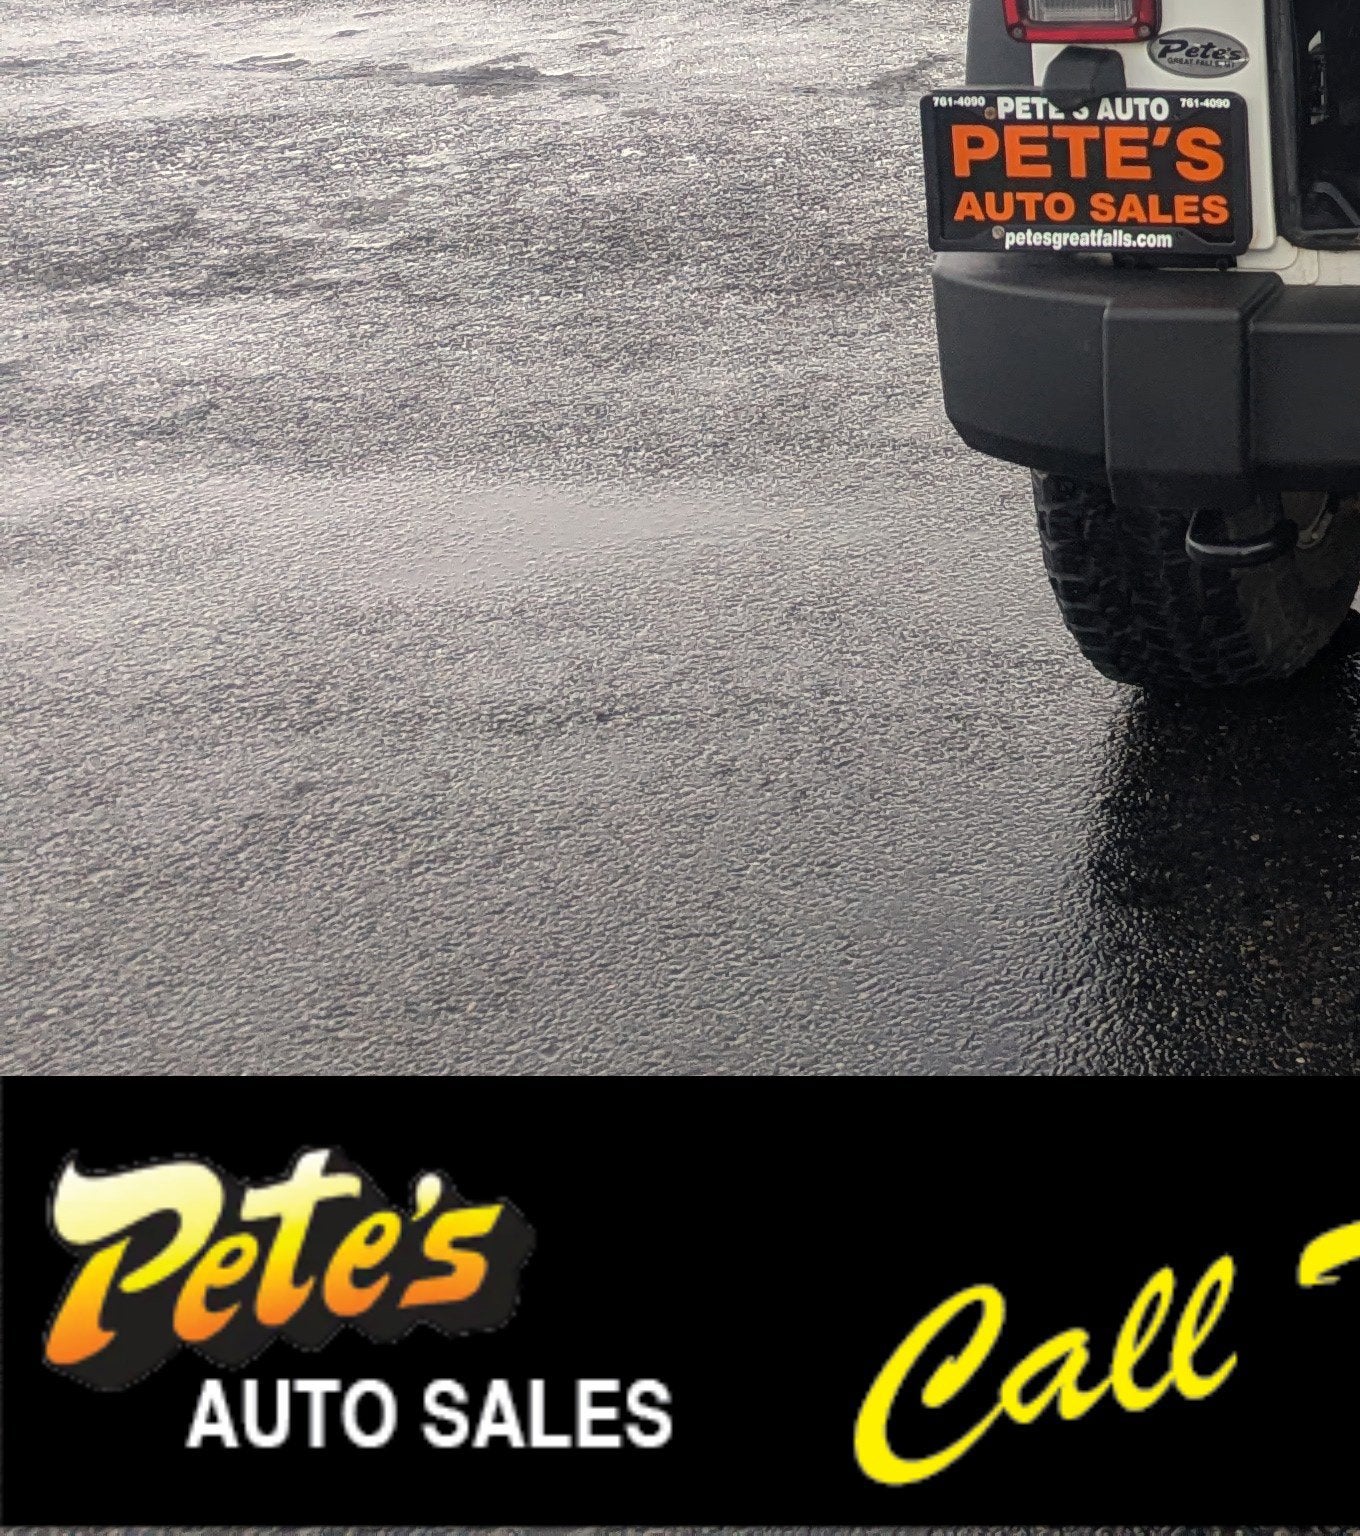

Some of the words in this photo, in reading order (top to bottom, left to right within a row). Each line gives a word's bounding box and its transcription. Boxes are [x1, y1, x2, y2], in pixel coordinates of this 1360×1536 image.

[1158, 39, 1241, 61] Pete's
[1168, 57, 1193, 65] GREAT
[932, 95, 986, 108] 761-4090
[1096, 97, 1170, 121] AUTO
[1179, 97, 1231, 109] 761-4090
[952, 124, 1225, 183] PETE'S
[954, 191, 1076, 222] AUTO
[1090, 192, 1230, 225] SALES
[1005, 228, 1173, 251] petesgreatfalls.com
